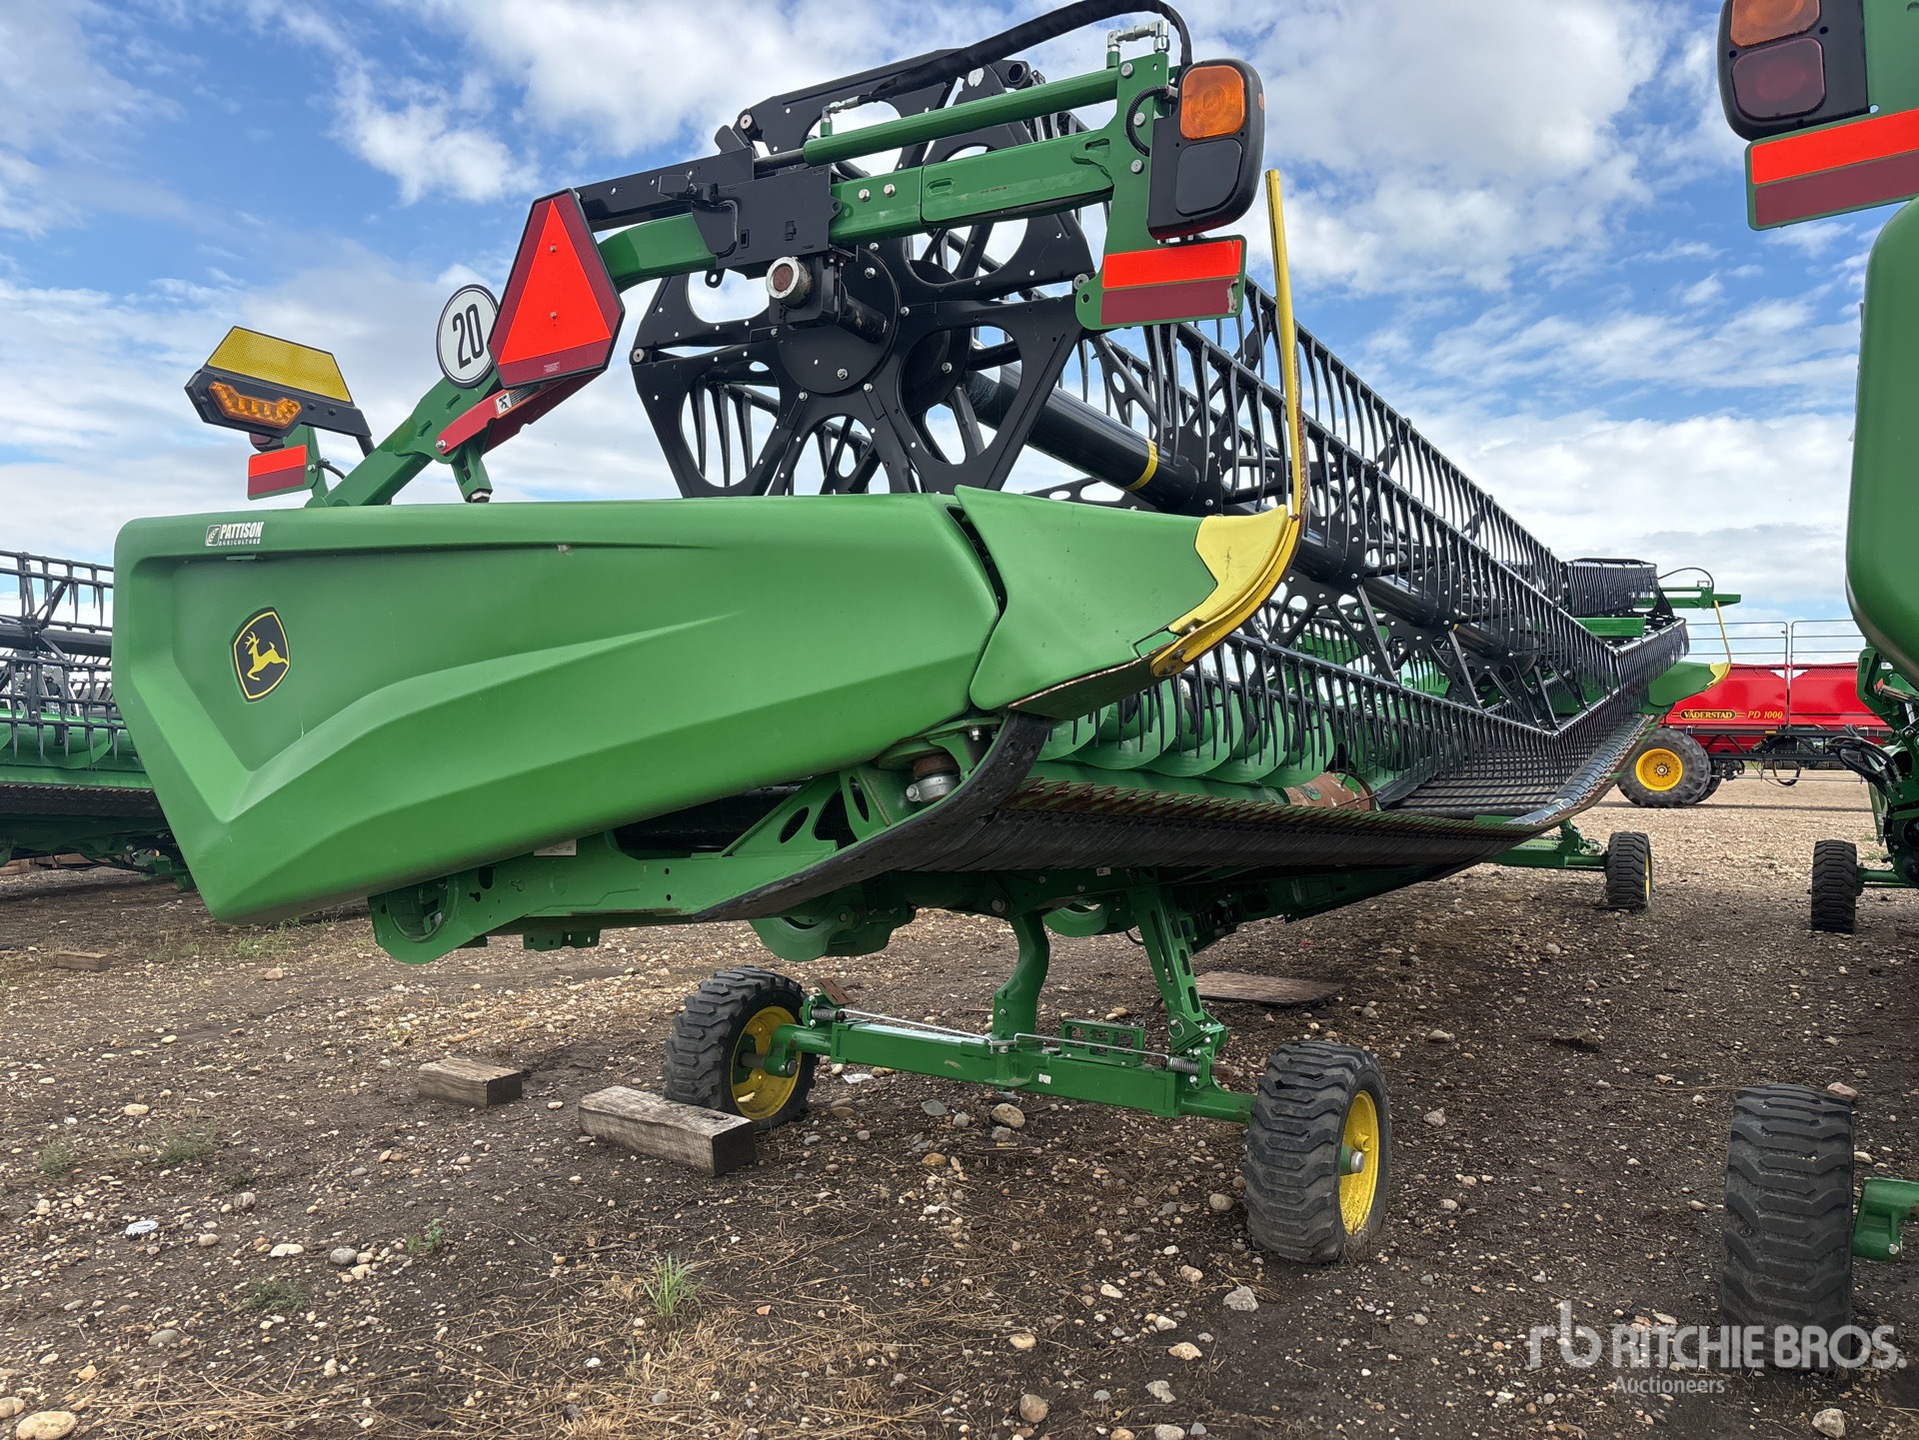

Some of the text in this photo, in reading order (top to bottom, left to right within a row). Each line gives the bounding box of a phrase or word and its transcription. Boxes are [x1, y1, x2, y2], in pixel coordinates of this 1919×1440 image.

[452, 303, 485, 369] 20
[219, 521, 265, 540] PATTISON
[218, 537, 261, 546] AGRICULTURE
[1684, 709, 1733, 719] VÄDERSTAD
[1747, 710, 1783, 719] PD 1000
